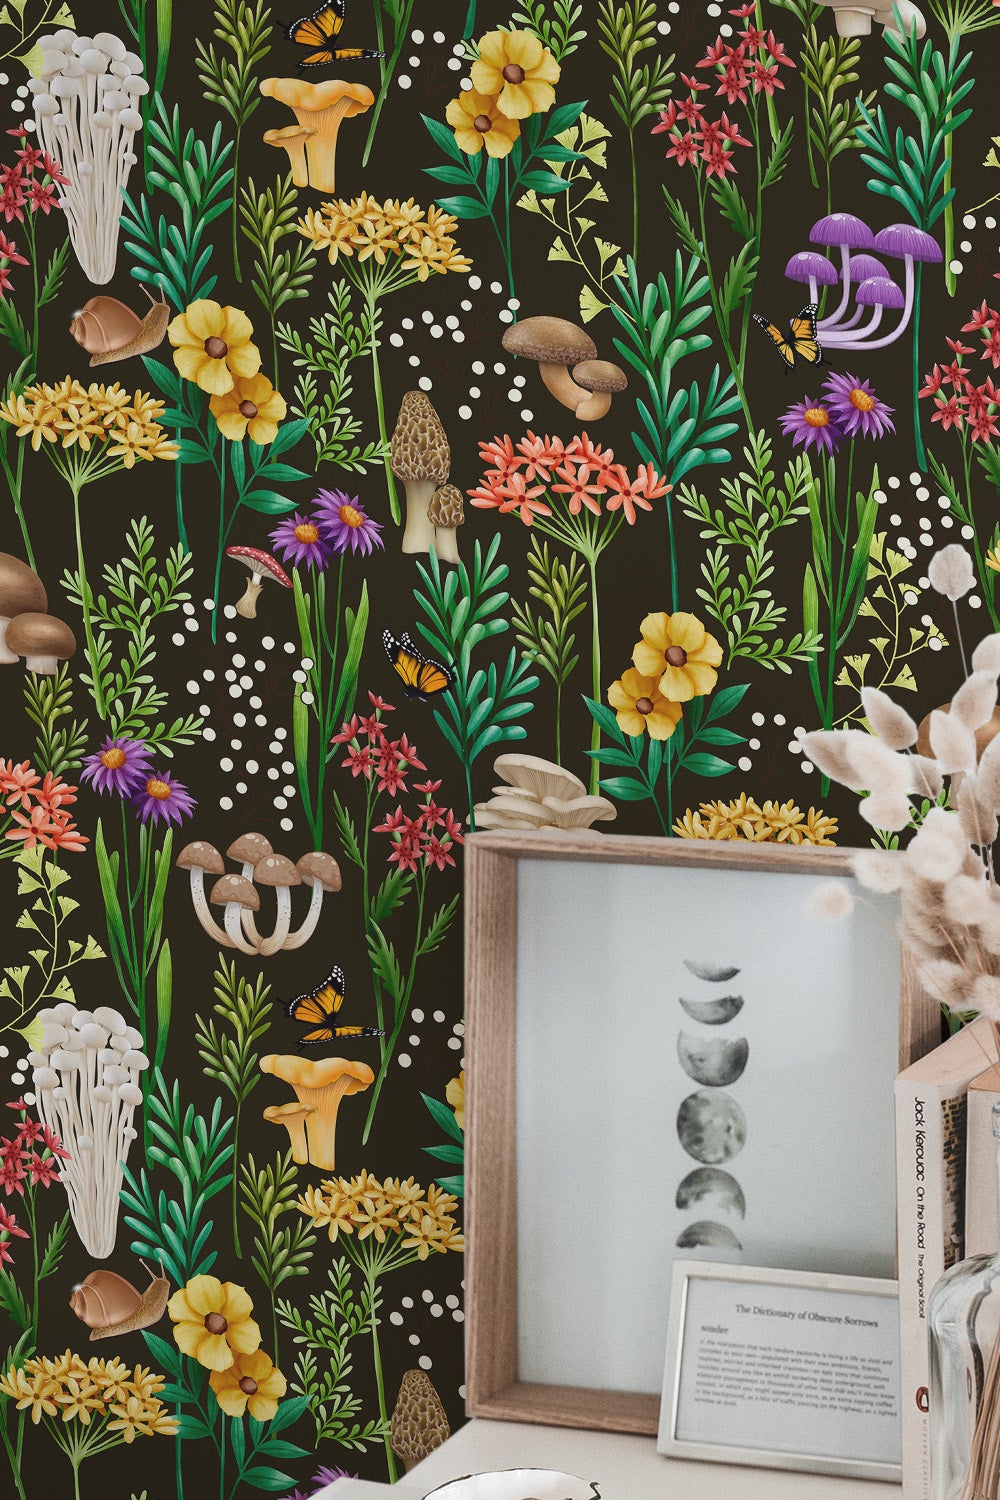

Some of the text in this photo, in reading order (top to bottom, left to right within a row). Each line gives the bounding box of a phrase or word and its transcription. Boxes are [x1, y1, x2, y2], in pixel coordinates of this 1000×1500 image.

[914, 1097, 926, 1127] Jack
[915, 1130, 927, 1181] Kerouac
[916, 1186, 927, 1202] On
[916, 1204, 926, 1220] the
[917, 1222, 927, 1249] Road
[918, 1253, 926, 1267] The
[917, 1267, 927, 1298] Original
[735, 1304, 879, 1328] The Dictionary of Obscure Sorrows
